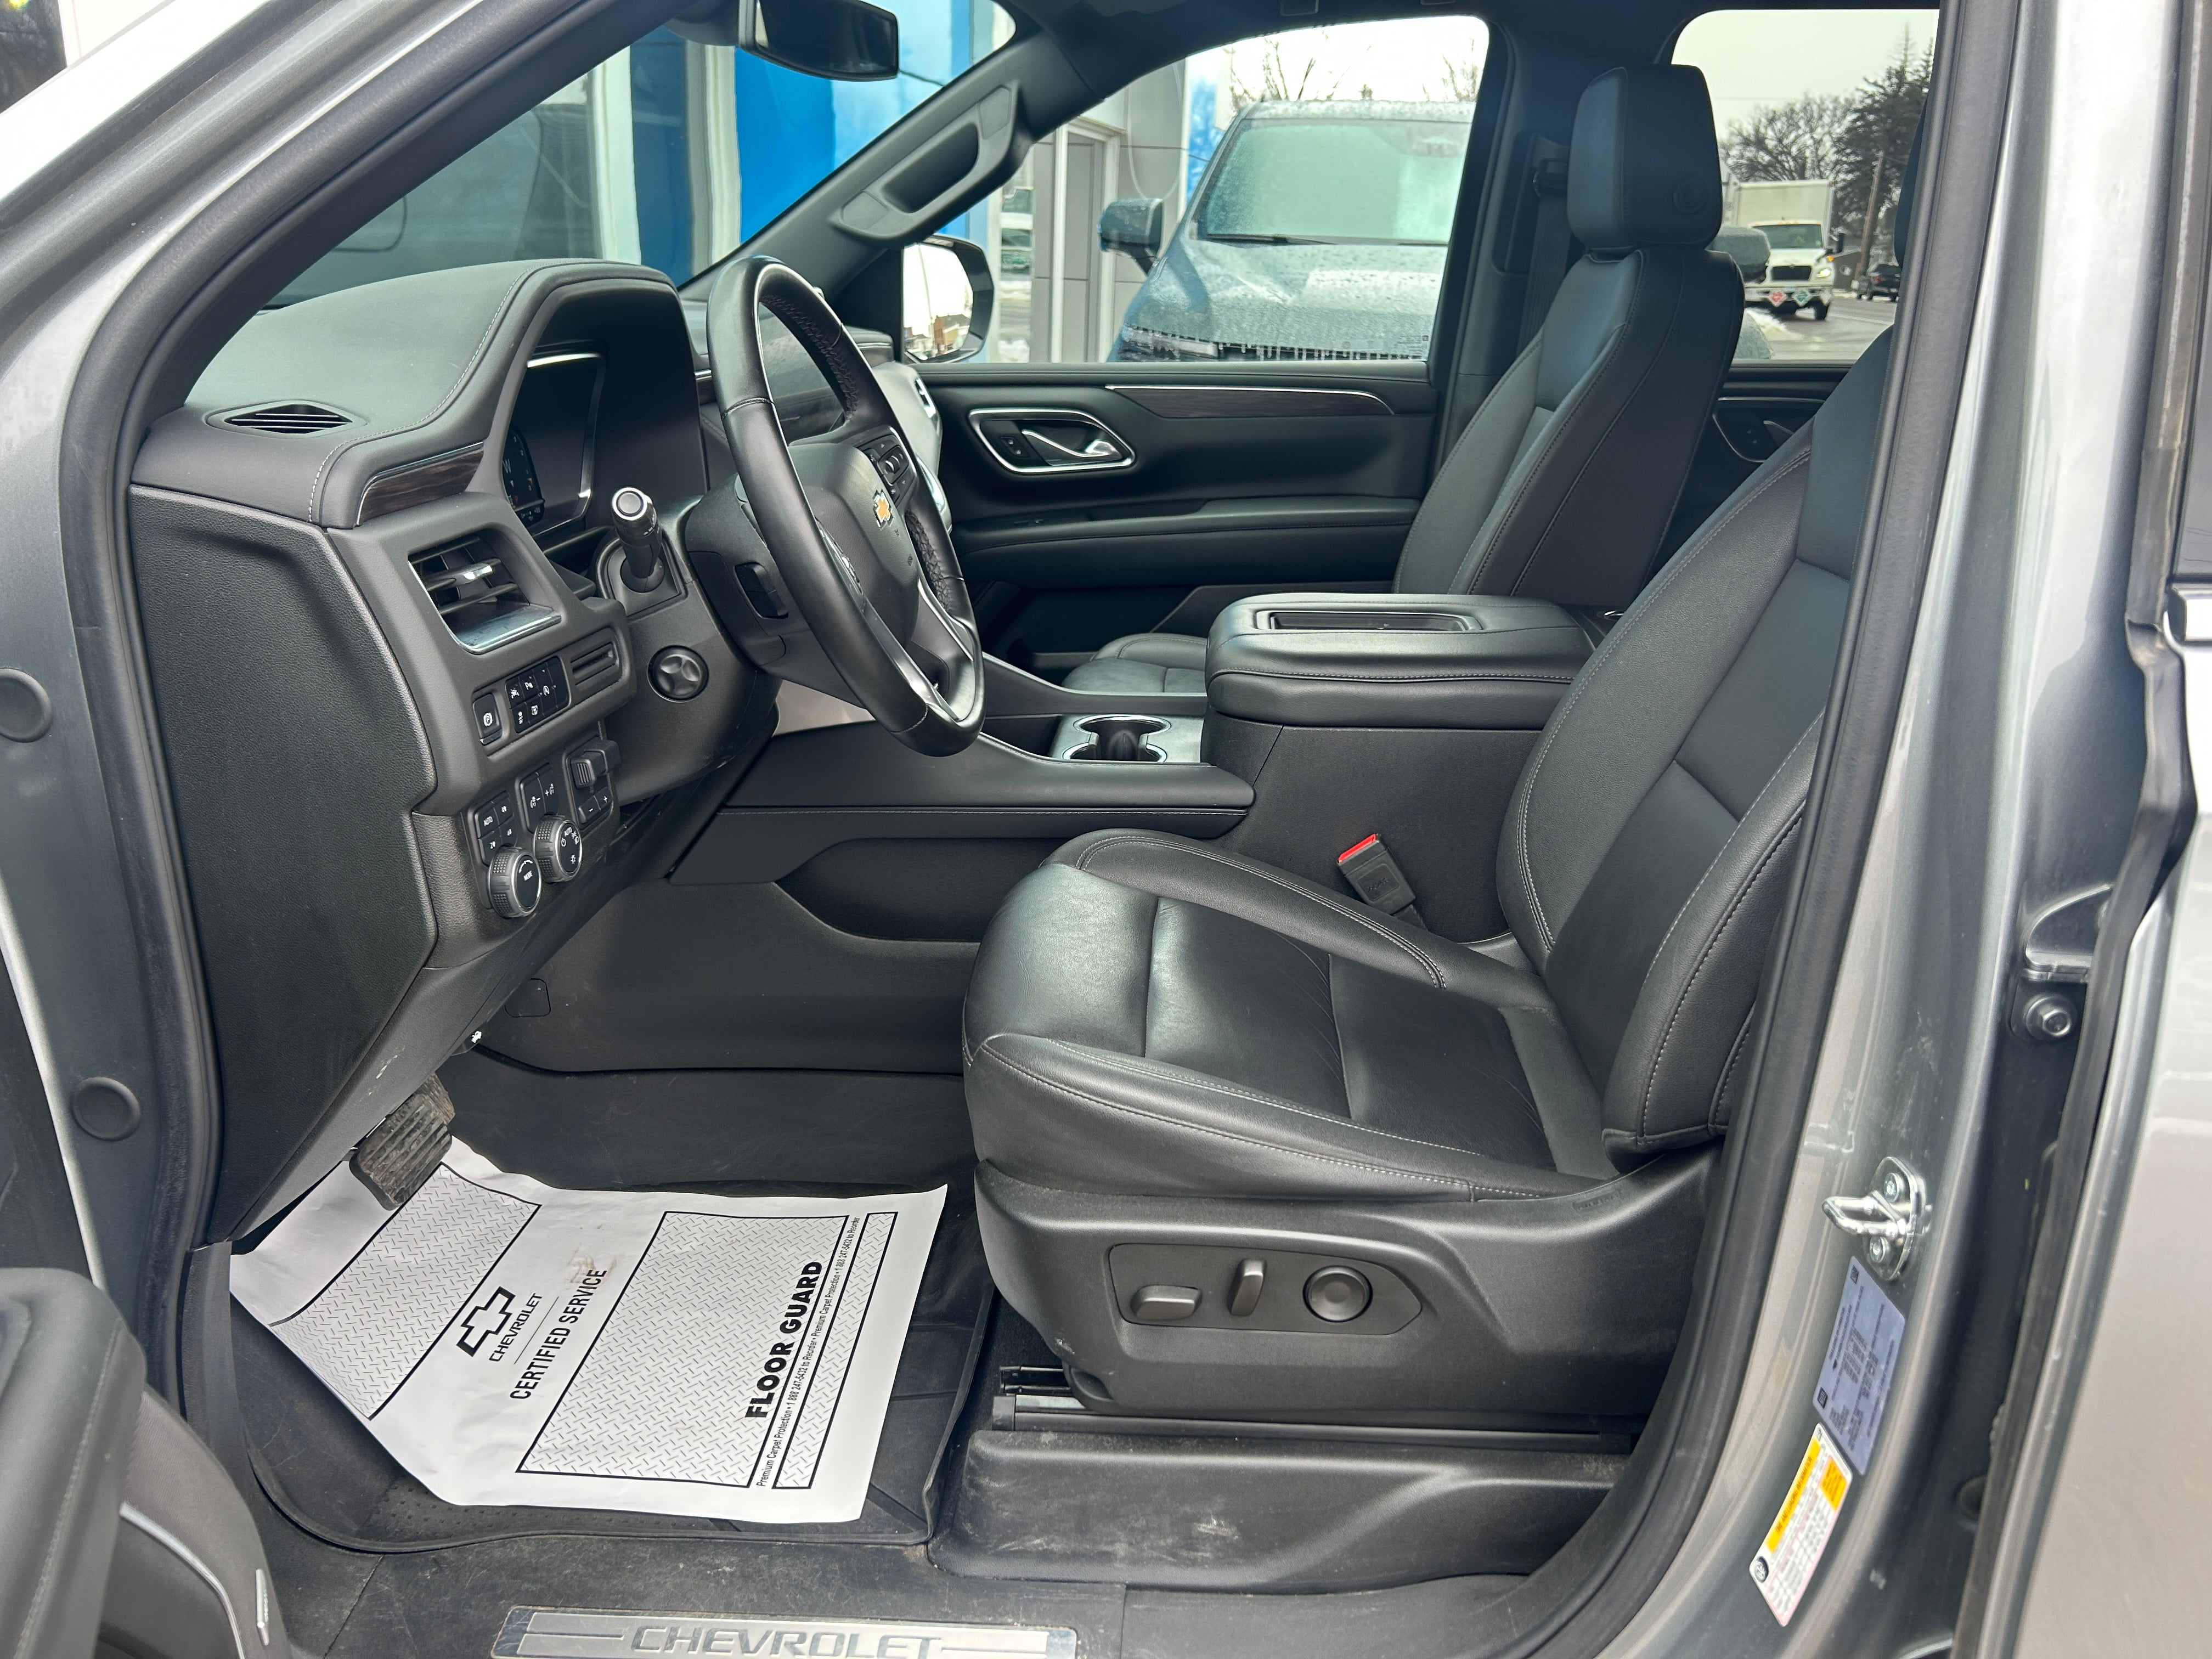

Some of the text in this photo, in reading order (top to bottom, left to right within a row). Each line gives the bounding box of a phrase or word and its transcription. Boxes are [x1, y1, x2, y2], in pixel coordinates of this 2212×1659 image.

[825, 1274, 840, 1299] Protection
[819, 1297, 833, 1314] Carpet
[489, 1293, 543, 1362] CHEVROLET
[510, 1269, 607, 1399] CERTIFIED SERVICE
[745, 1261, 822, 1418] FLOOR GUARD
[811, 1316, 826, 1337] Premium
[806, 1341, 817, 1361] Reorder
[793, 1367, 808, 1390] 247-5432
[774, 1410, 792, 1439] Protection
[767, 1438, 782, 1459] Carpet
[756, 1460, 774, 1487] Premium
[631, 1624, 943, 1659] CHEVROLET
